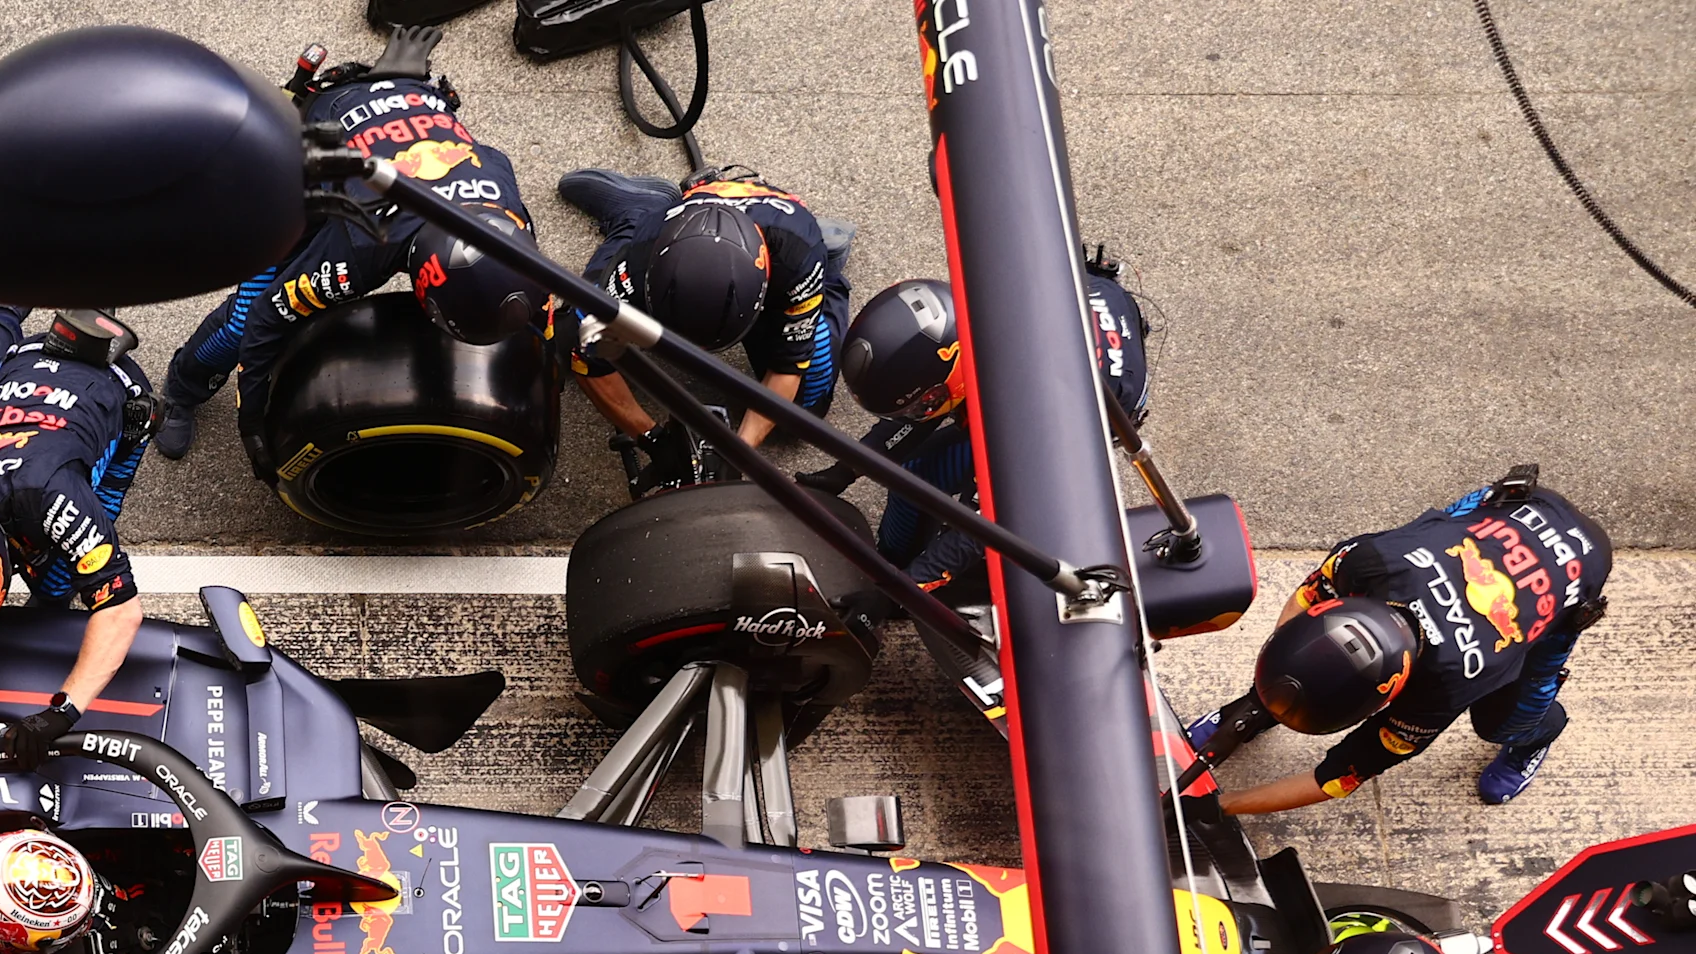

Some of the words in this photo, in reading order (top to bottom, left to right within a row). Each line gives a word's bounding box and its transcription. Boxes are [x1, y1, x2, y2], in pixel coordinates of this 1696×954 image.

[1466, 516, 1541, 577] Bull
[1537, 527, 1583, 607] Mobil
[732, 615, 786, 636] Hard
[781, 619, 828, 641] Rock
[1403, 547, 1485, 680] ORACLE
[1409, 598, 1446, 647] sparco
[1515, 565, 1558, 643] Red
[207, 685, 225, 735] PEPE
[82, 732, 142, 762] BYBIT
[155, 764, 208, 822] ORACLE
[203, 839, 222, 880] HEUER
[225, 839, 239, 878] TAG
[308, 831, 343, 864] Re
[9, 909, 51, 928] Heineken
[497, 851, 526, 935] TAG
[533, 847, 571, 938] HEUER
[795, 869, 826, 942] VISA
[833, 886, 857, 945] CDW
[866, 872, 892, 946] zoom
[889, 874, 905, 921] ARCTIC
[901, 879, 918, 915] WOLF
[917, 875, 942, 949] PIRELLI
[941, 878, 959, 950] infinitum
[960, 899, 980, 951] Mobil
